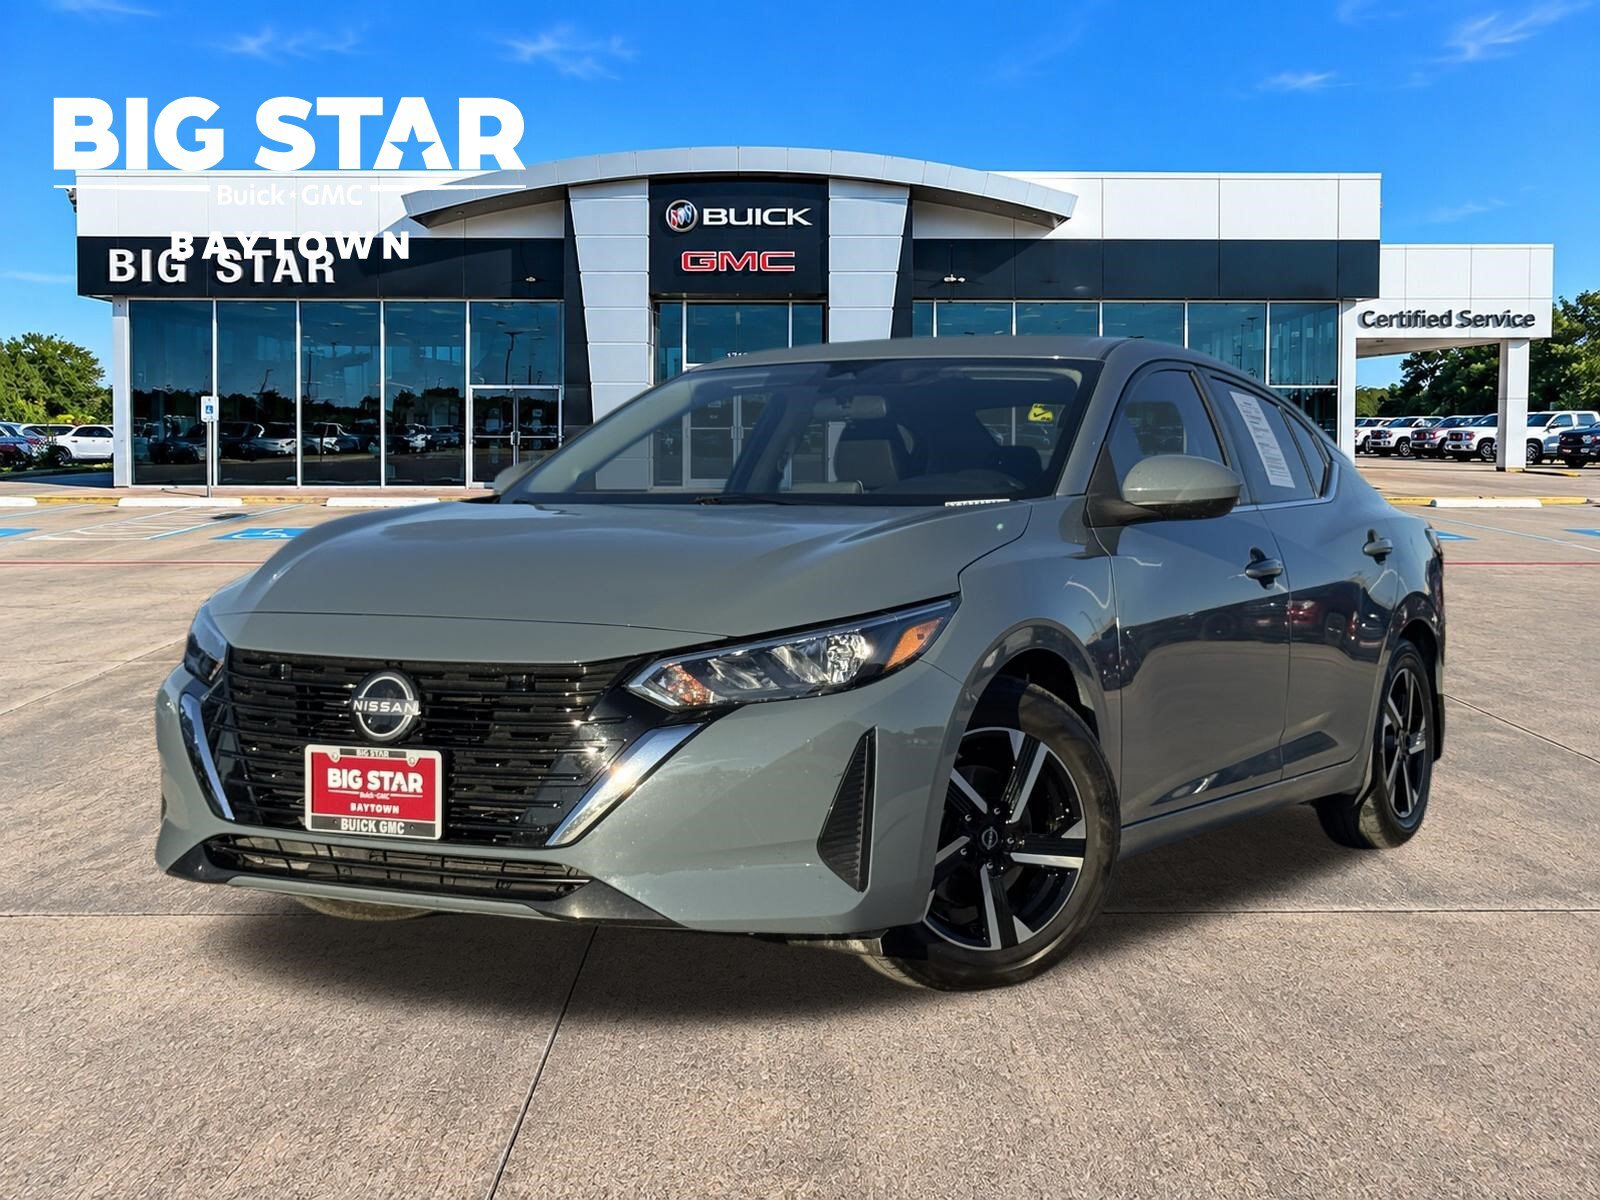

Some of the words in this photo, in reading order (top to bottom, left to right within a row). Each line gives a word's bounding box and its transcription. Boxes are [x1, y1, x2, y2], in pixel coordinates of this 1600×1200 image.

[703, 208, 813, 226] BUICK
[108, 249, 188, 283] BIG
[216, 249, 335, 283] STAR
[681, 250, 796, 272] GMC
[1358, 310, 1453, 328] Certified
[1455, 310, 1536, 328] Service
[353, 700, 419, 715] NISSAN
[356, 749, 369, 757] BIG
[370, 750, 390, 758] STAR
[327, 768, 363, 790] BIG
[367, 770, 423, 793] STAR
[350, 802, 400, 814] BAYTOWN
[341, 818, 377, 833] BUICK
[379, 821, 405, 835] GMC
